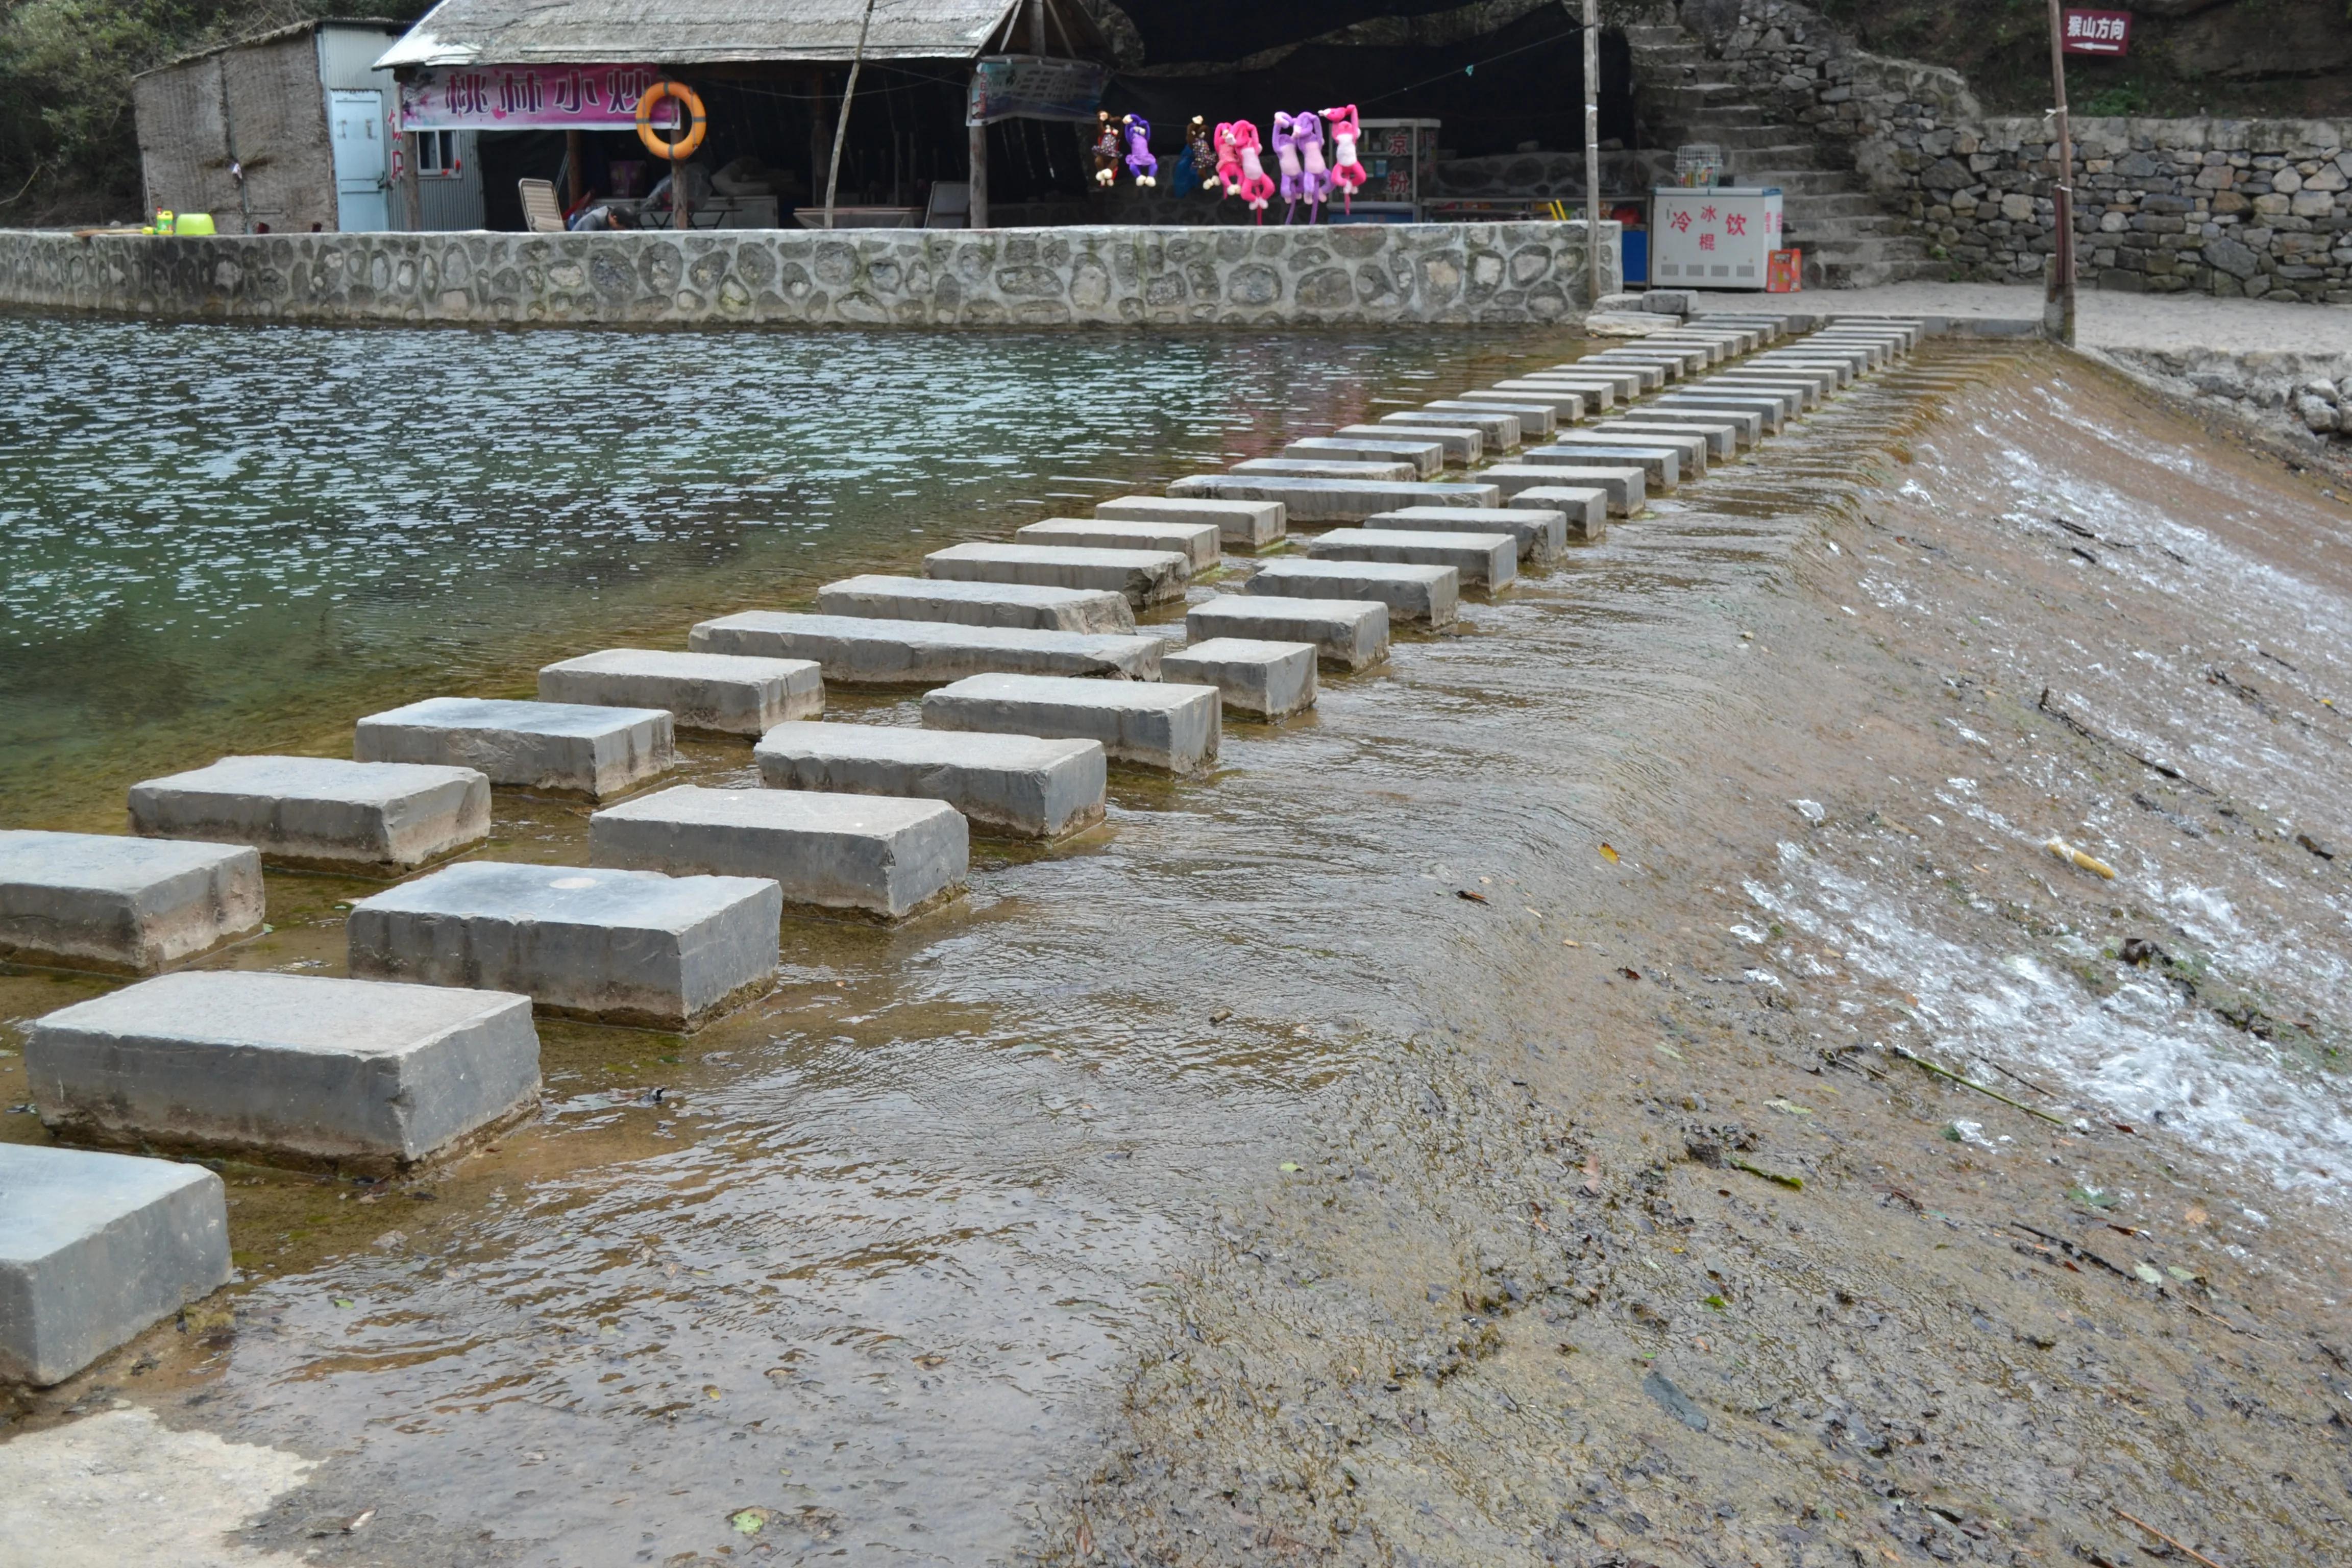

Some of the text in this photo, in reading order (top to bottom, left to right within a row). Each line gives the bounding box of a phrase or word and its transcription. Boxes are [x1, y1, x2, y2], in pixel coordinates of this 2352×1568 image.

[446, 69, 651, 114] 桃林小炒
[1387, 134, 1410, 193] 凉粉
